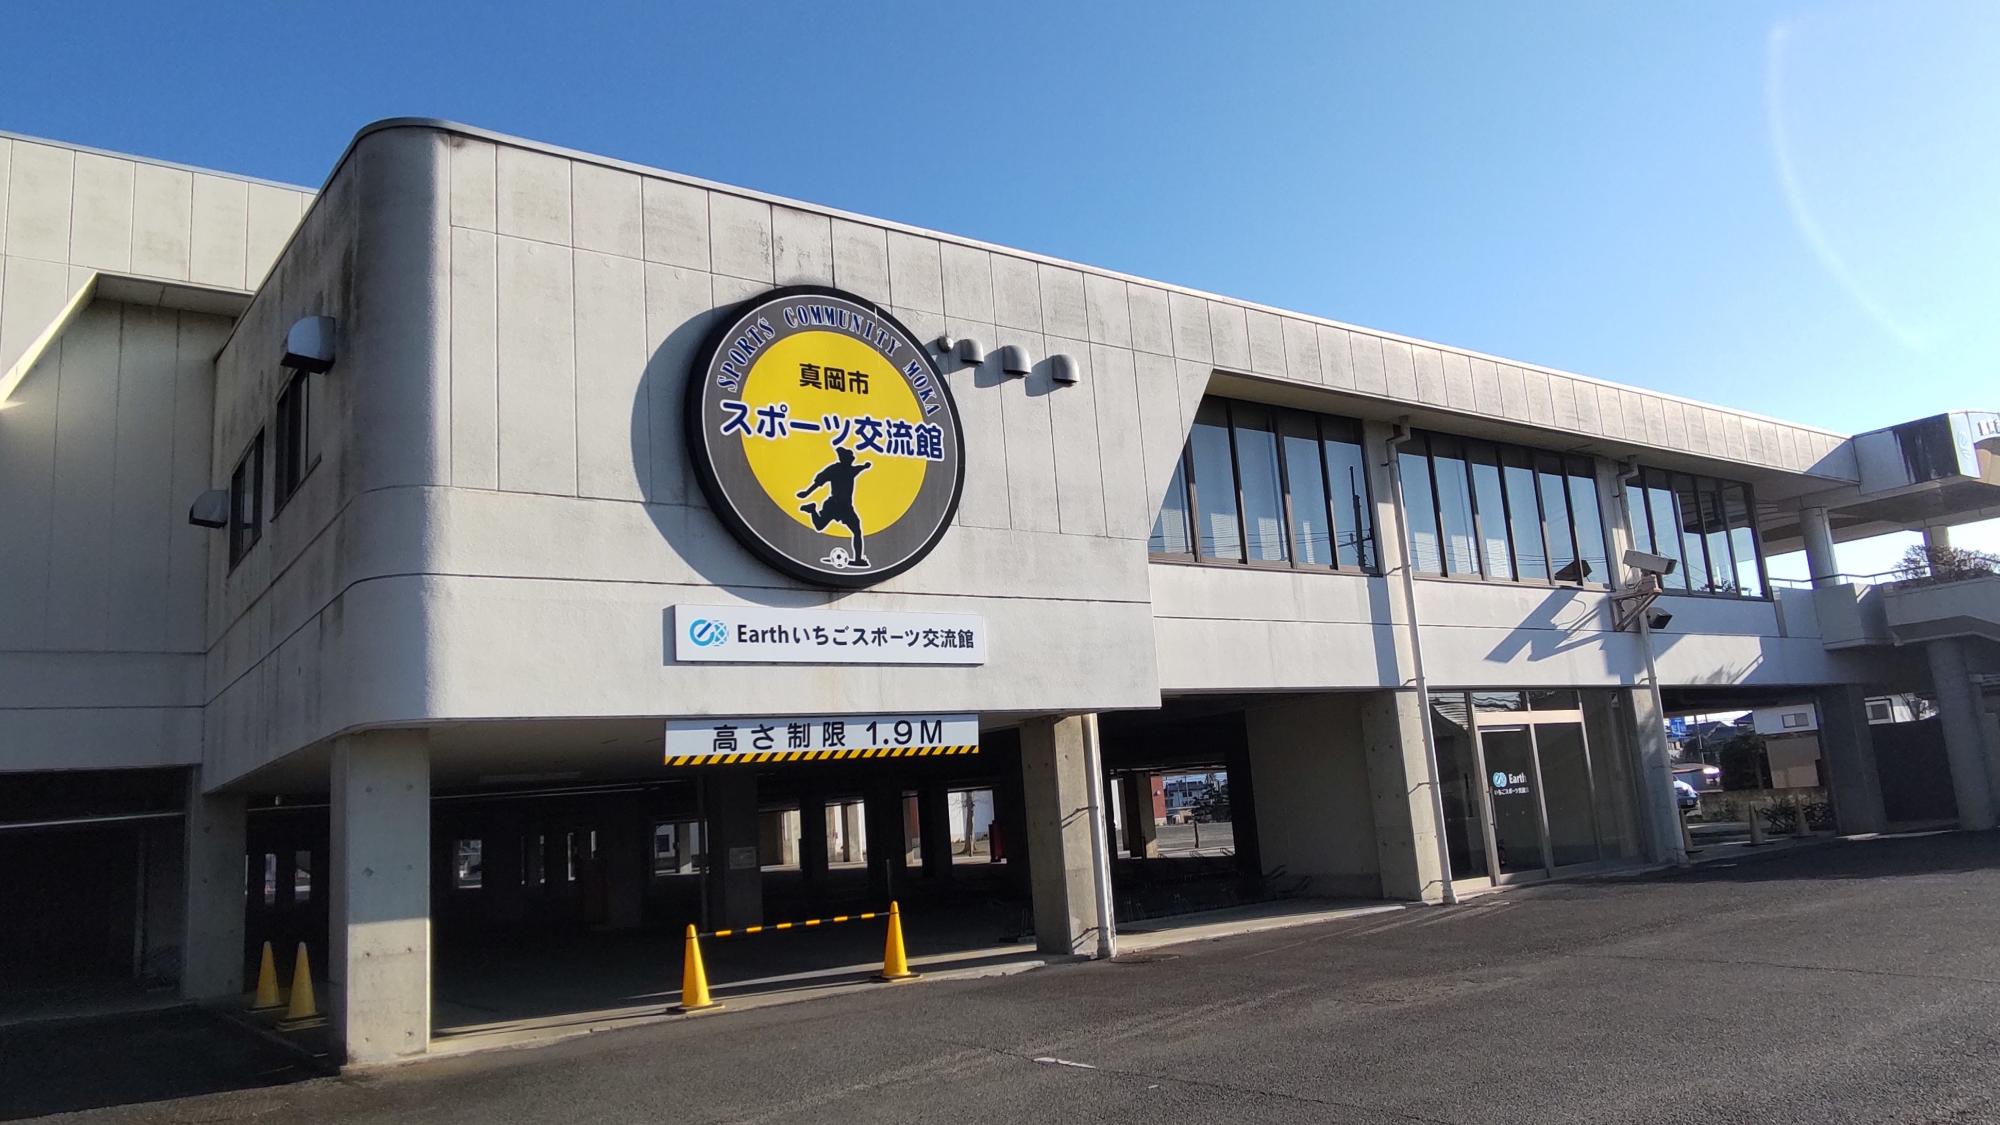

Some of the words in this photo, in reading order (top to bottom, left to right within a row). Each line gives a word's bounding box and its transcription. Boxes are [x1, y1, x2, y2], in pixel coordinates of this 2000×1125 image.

[717, 317, 776, 393] SPORTS
[783, 304, 902, 358] COMMUNITY
[902, 359, 942, 416] MOKA
[799, 363, 869, 395] 真岡市
[720, 399, 944, 462] スポーツ交流館
[1508, 772, 1527, 784] Earth
